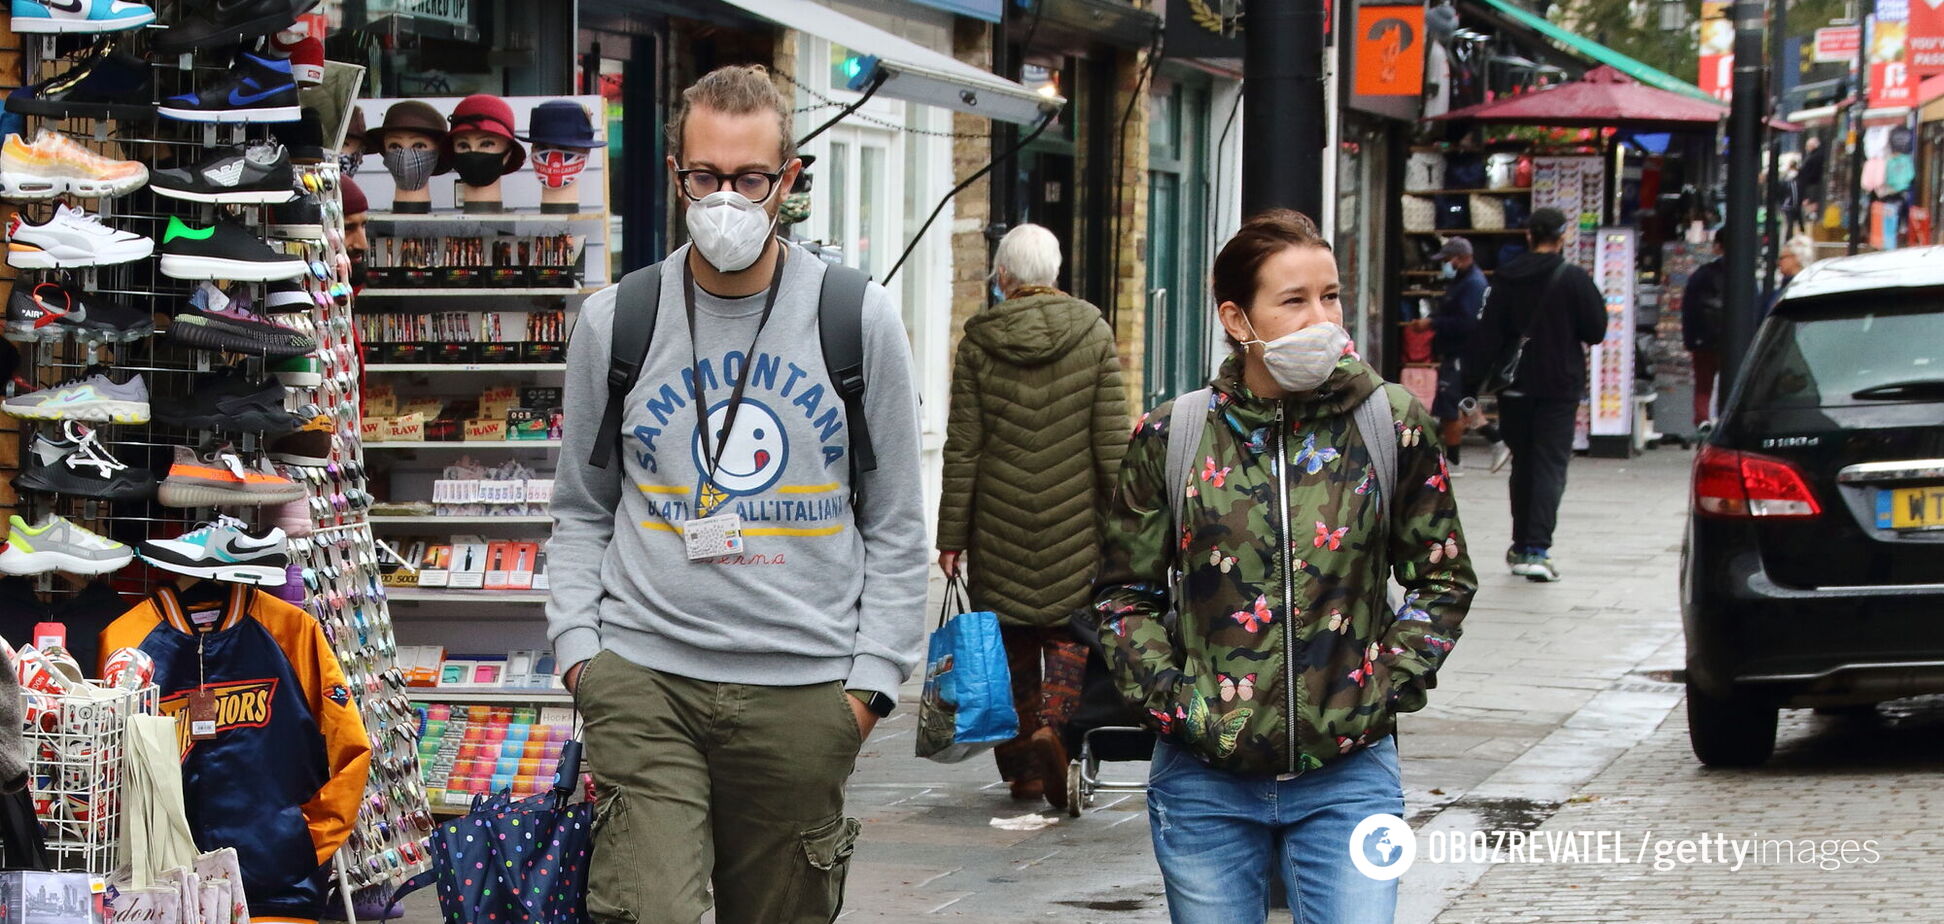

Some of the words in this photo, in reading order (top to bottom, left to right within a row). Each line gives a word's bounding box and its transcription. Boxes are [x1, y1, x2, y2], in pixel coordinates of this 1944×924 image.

[22, 309, 44, 318] "AIR"
[634, 350, 845, 473] SAMMONTANA
[362, 423, 378, 433] AW
[391, 424, 419, 436] RAW
[471, 423, 499, 436] RAW
[736, 495, 844, 522] ALL'ITALIANA
[112, 897, 156, 922] don
